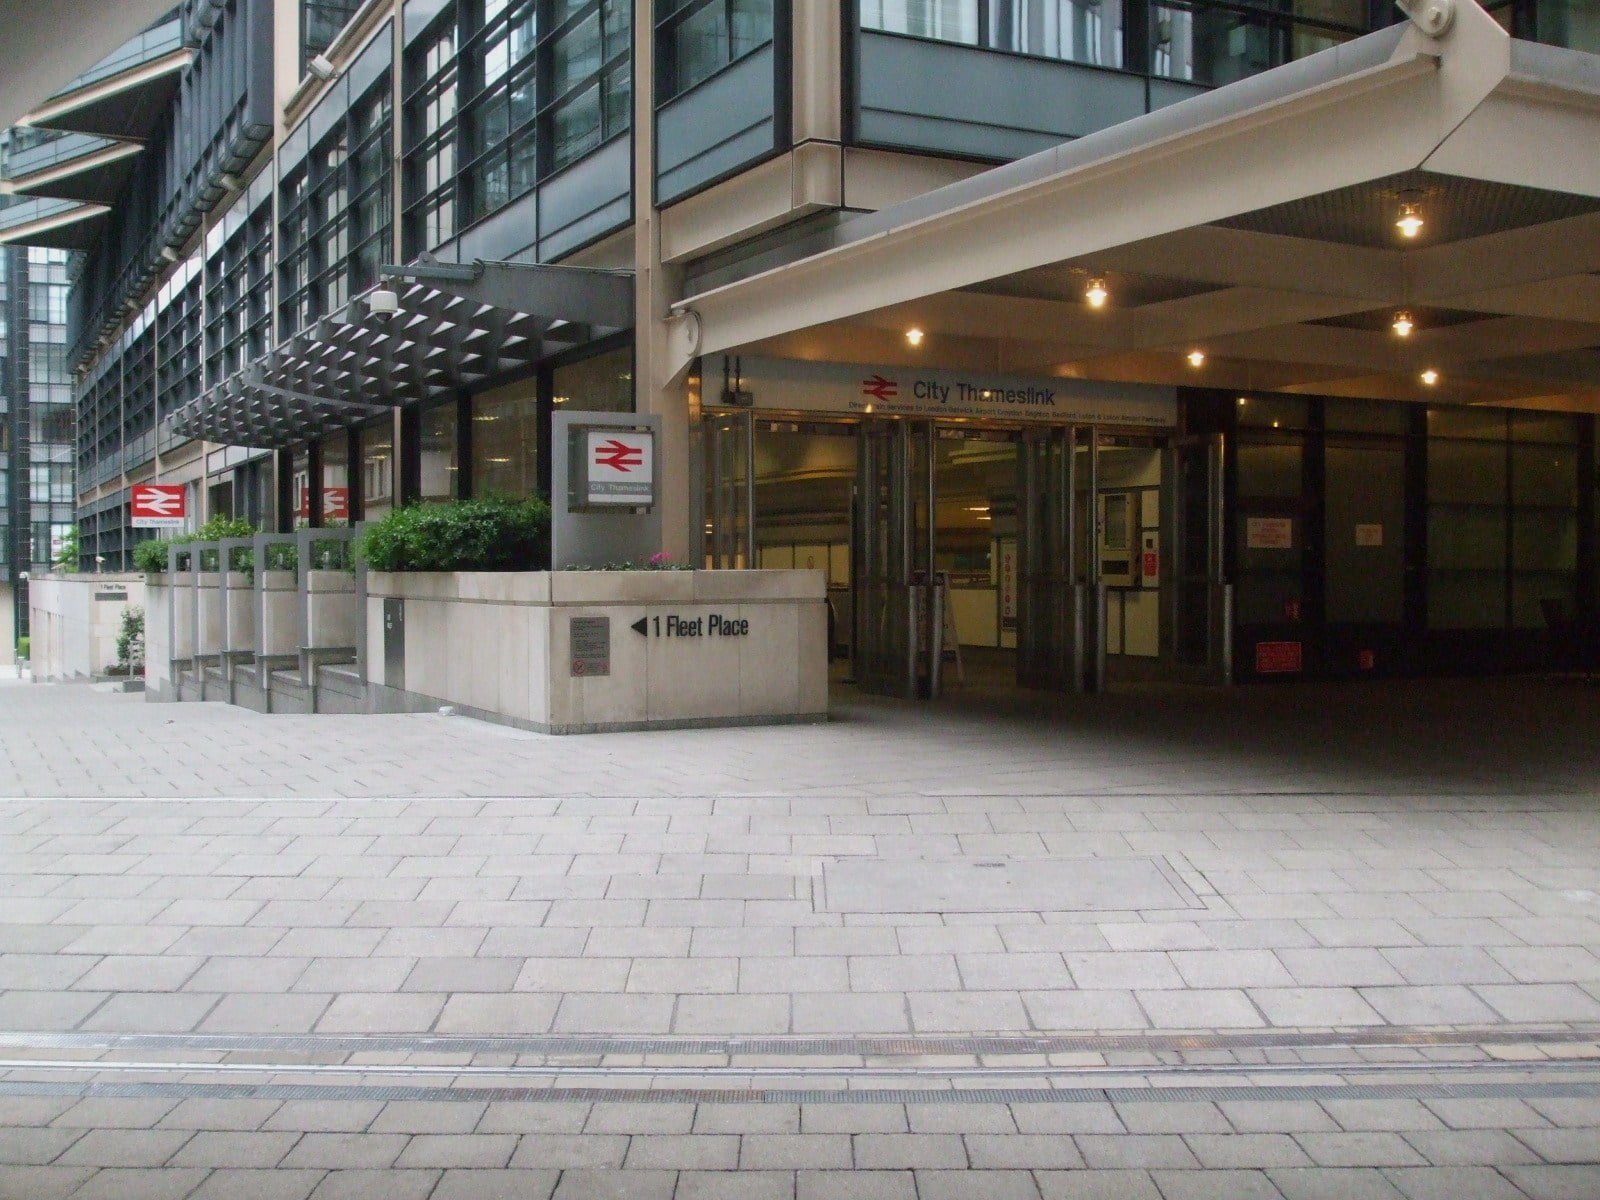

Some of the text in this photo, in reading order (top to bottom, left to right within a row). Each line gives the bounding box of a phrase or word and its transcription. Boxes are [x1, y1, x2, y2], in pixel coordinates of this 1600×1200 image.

[913, 380, 1056, 405] City Thameslink
[591, 483, 605, 492] City
[653, 614, 749, 637] 1 Fleet Place
